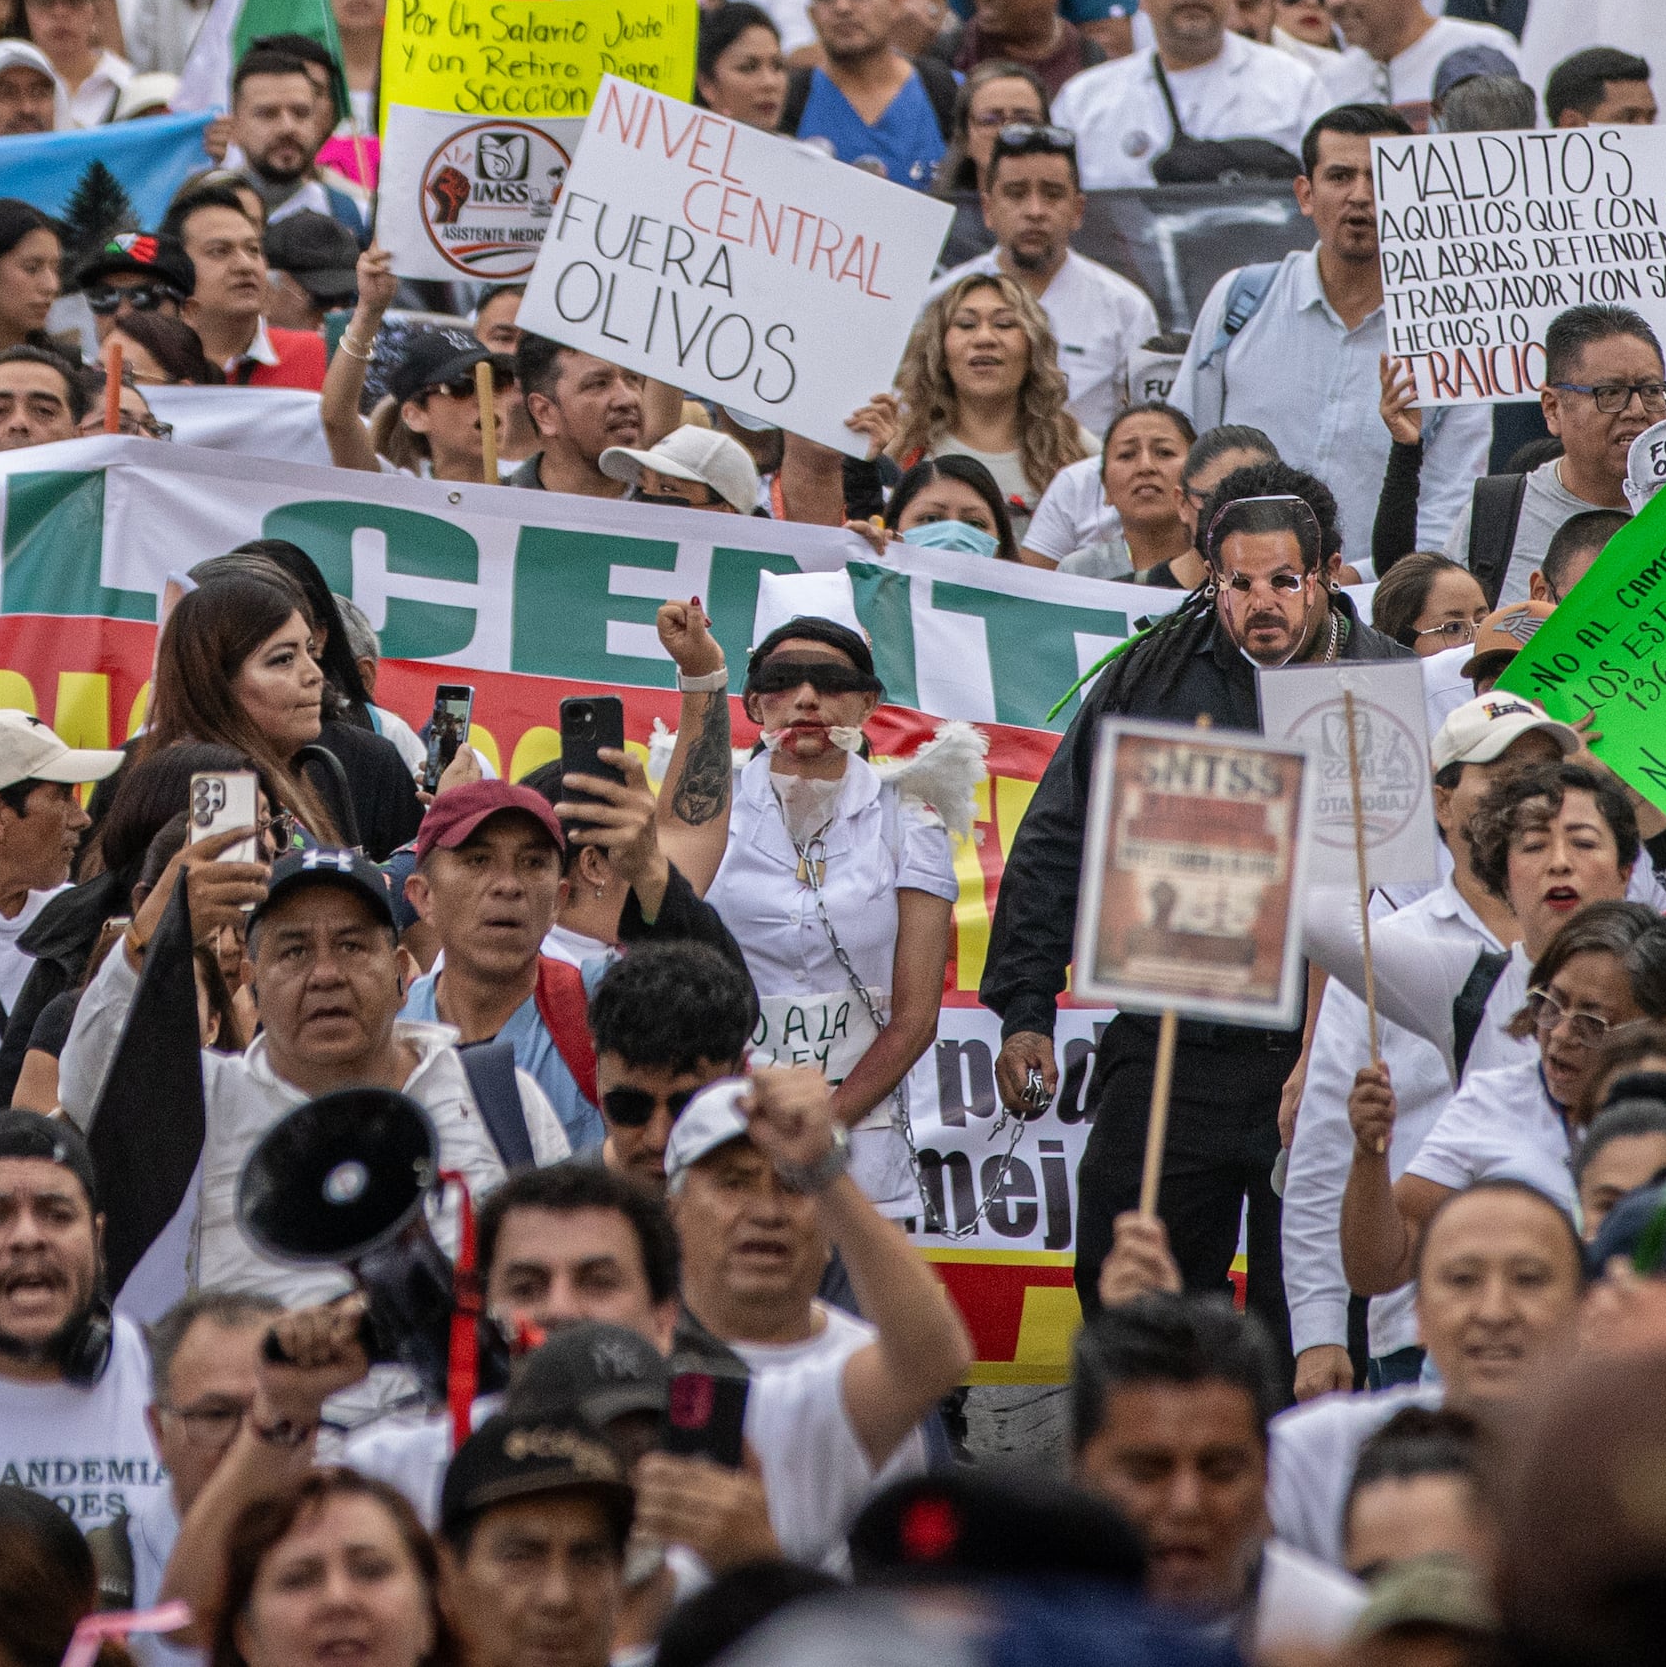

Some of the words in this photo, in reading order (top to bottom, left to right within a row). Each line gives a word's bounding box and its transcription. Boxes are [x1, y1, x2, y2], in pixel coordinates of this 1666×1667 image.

[490, 5, 588, 44] Salario
[479, 45, 580, 78] Retiro
[597, 83, 744, 185] NIVEL
[1376, 130, 1634, 202] MALDITOS
[473, 183, 529, 203] IMSS
[441, 225, 506, 242] ASISTENTE
[508, 228, 546, 244] MEDIC
[557, 191, 733, 298] FUERA
[682, 180, 892, 300] CENTRAL
[1379, 200, 1522, 244] AQUELLOS
[1525, 198, 1586, 233] QUE
[1594, 197, 1659, 230] CON
[1382, 238, 1528, 286] PALABRAS
[1385, 272, 1568, 321] TRABAJADOR
[1589, 267, 1642, 302] CON
[554, 261, 797, 405] OLIVOS
[1393, 317, 1490, 352] HECHOS
[1496, 313, 1531, 345] LO
[1391, 341, 1547, 401] TRAICIO
[1530, 650, 1581, 694] NO
[1576, 618, 1621, 651] AL
[1572, 659, 1630, 712] LOS
[783, 1006, 809, 1044] A
[816, 1000, 851, 1041] LA
